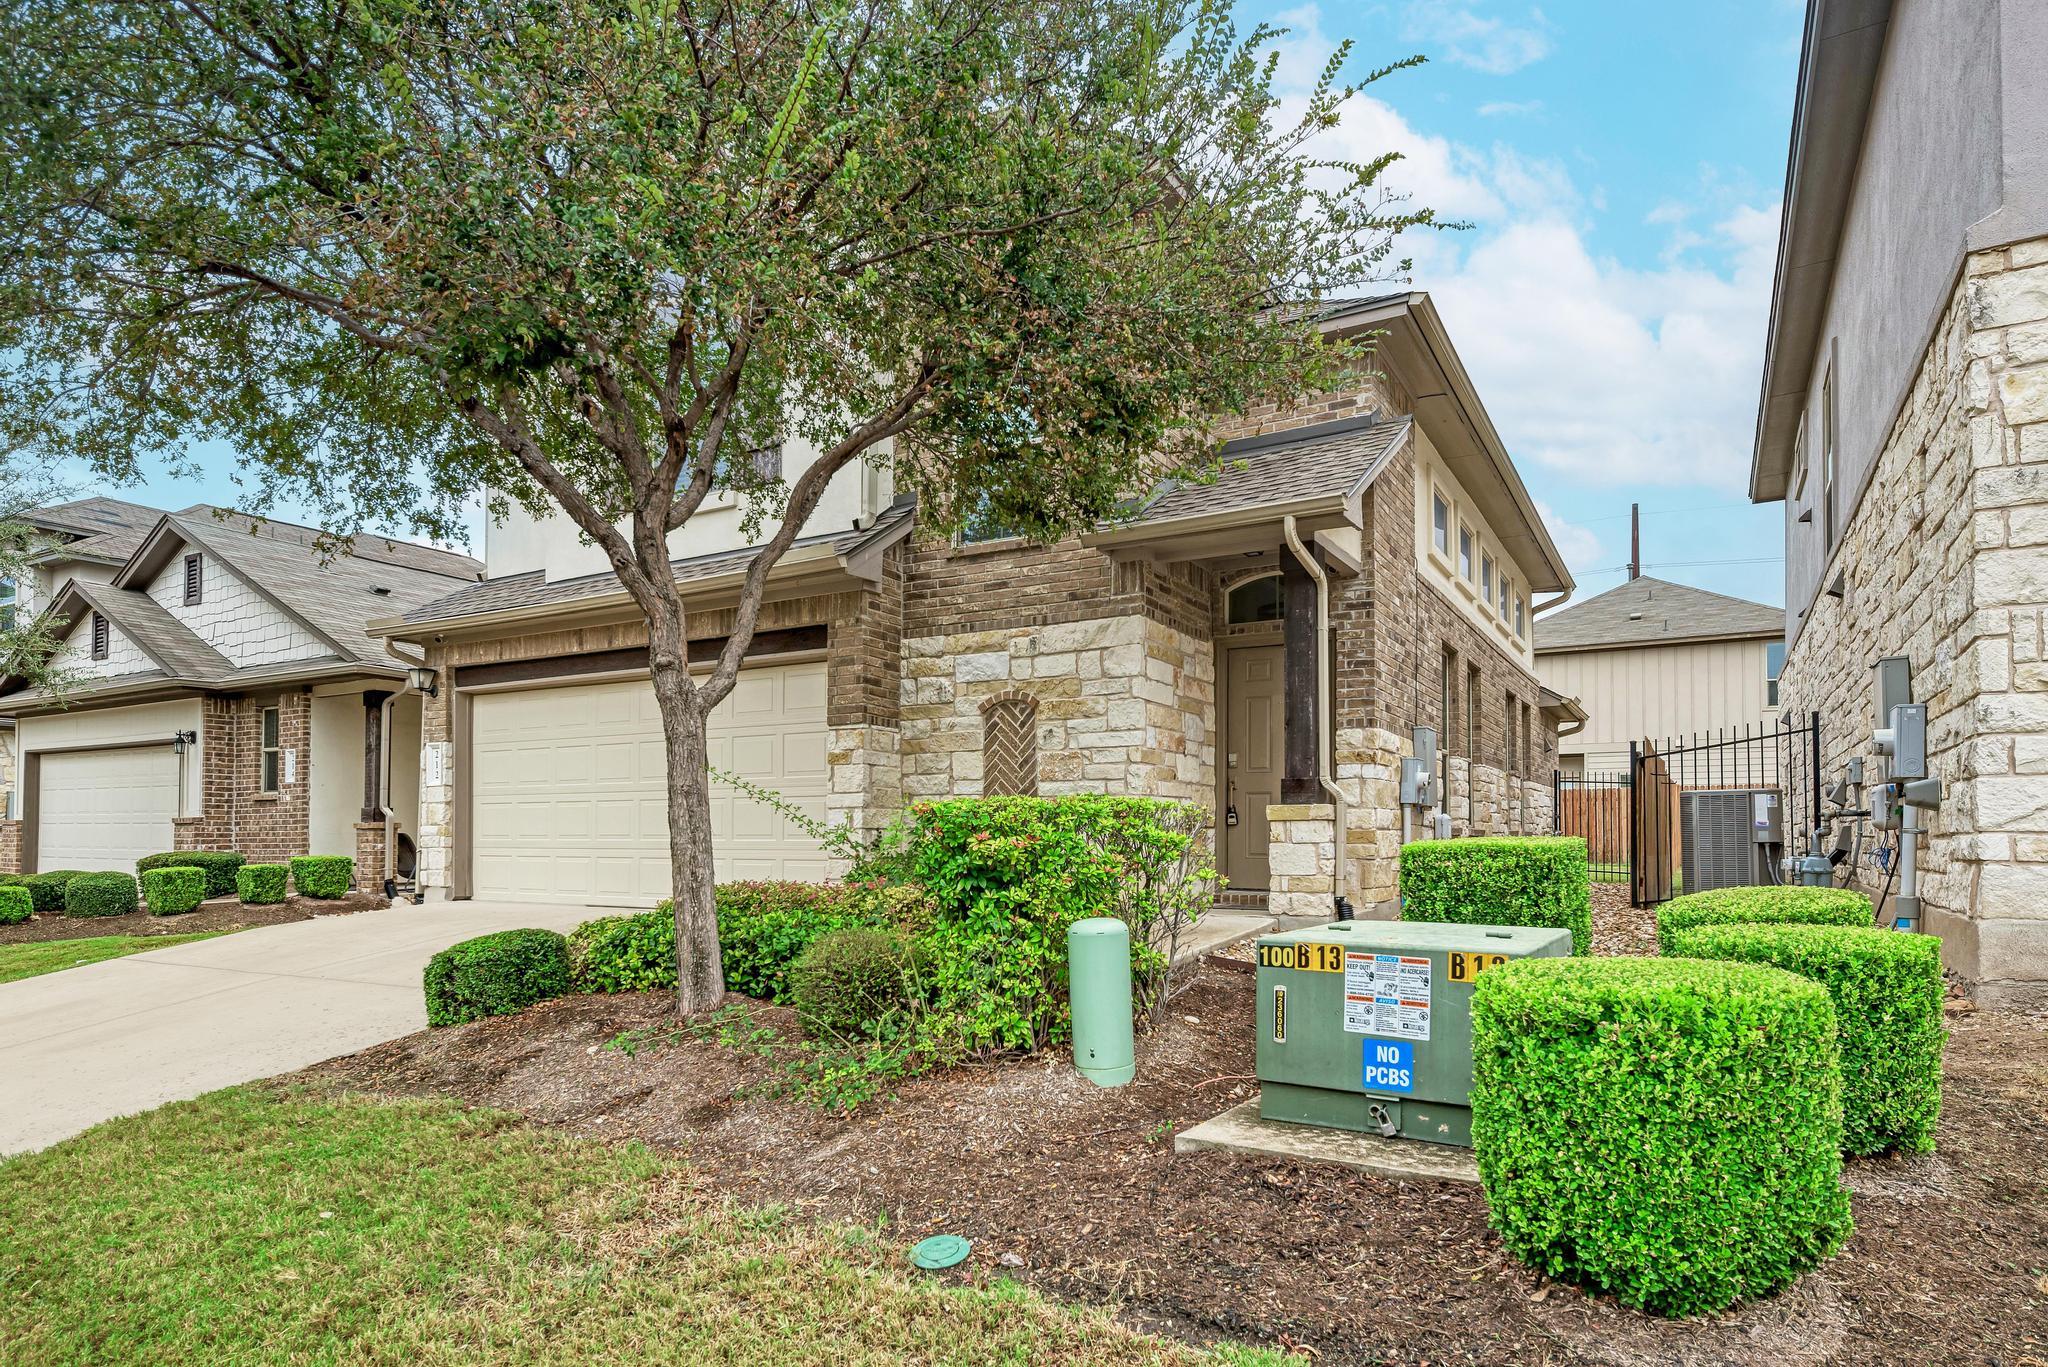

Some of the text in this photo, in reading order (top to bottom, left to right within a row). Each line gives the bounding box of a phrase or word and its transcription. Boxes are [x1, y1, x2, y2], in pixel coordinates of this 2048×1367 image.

[1260, 946, 1294, 967] 100
[1451, 952, 1505, 980] B1
[1376, 1045, 1400, 1064] NO
[1365, 1065, 1410, 1088] PCBS
